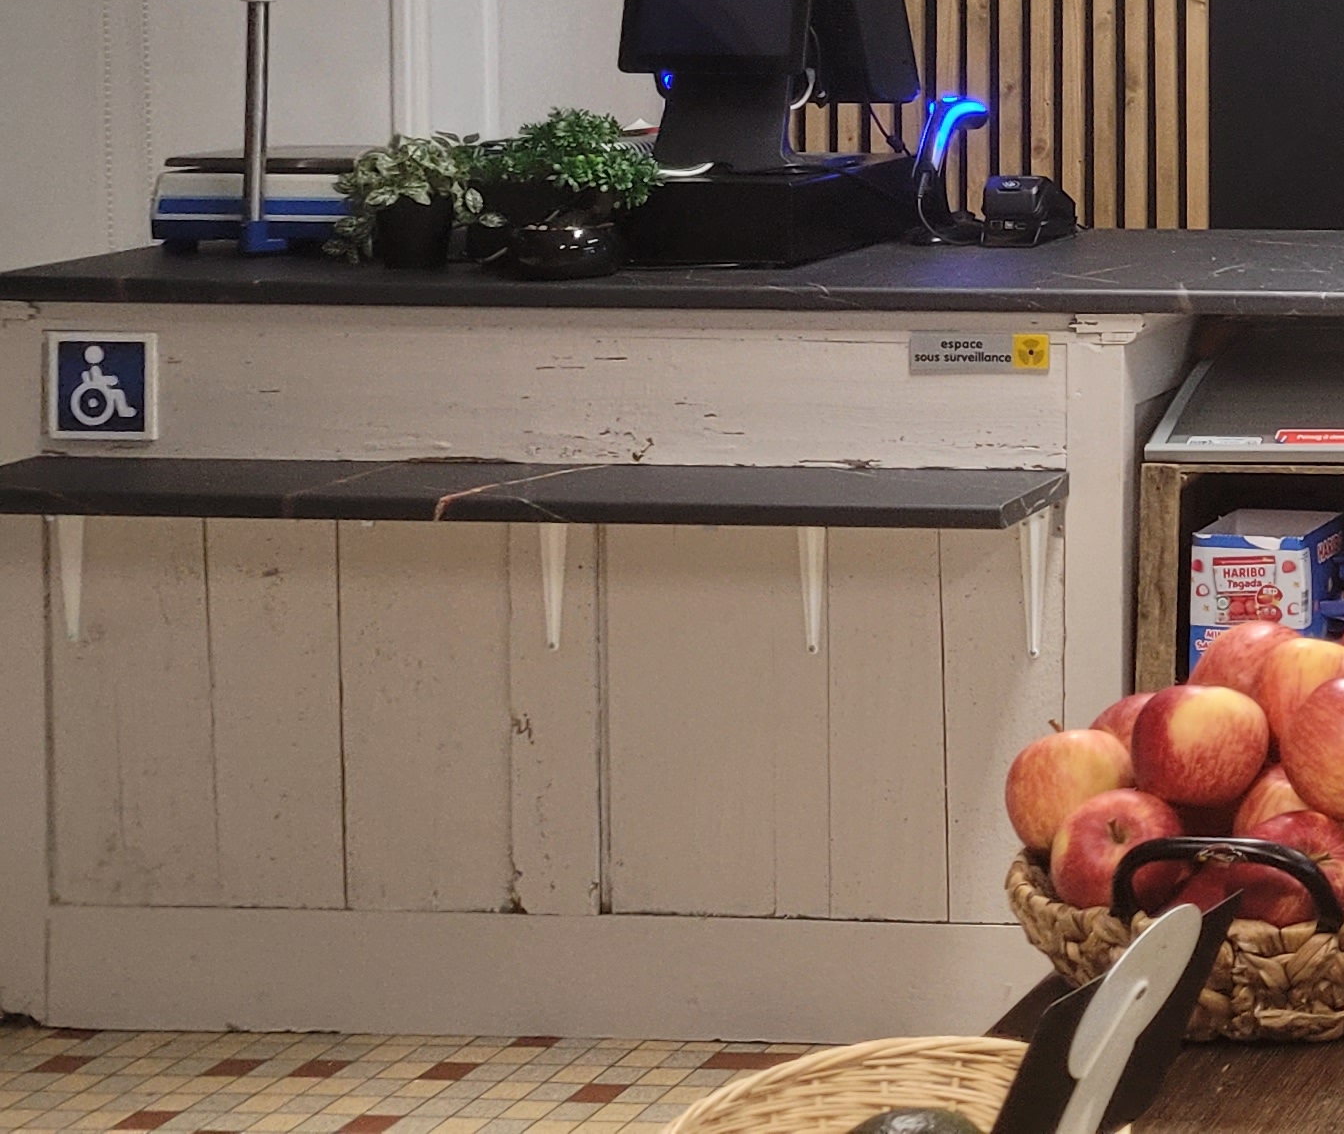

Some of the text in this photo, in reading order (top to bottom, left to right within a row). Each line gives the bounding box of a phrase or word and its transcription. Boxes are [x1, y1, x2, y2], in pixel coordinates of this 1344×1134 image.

[940, 340, 983, 351] espace
[914, 351, 1012, 363] sous surveillance
[1223, 567, 1266, 579] HARIBO
[1228, 579, 1262, 590] Tagada
